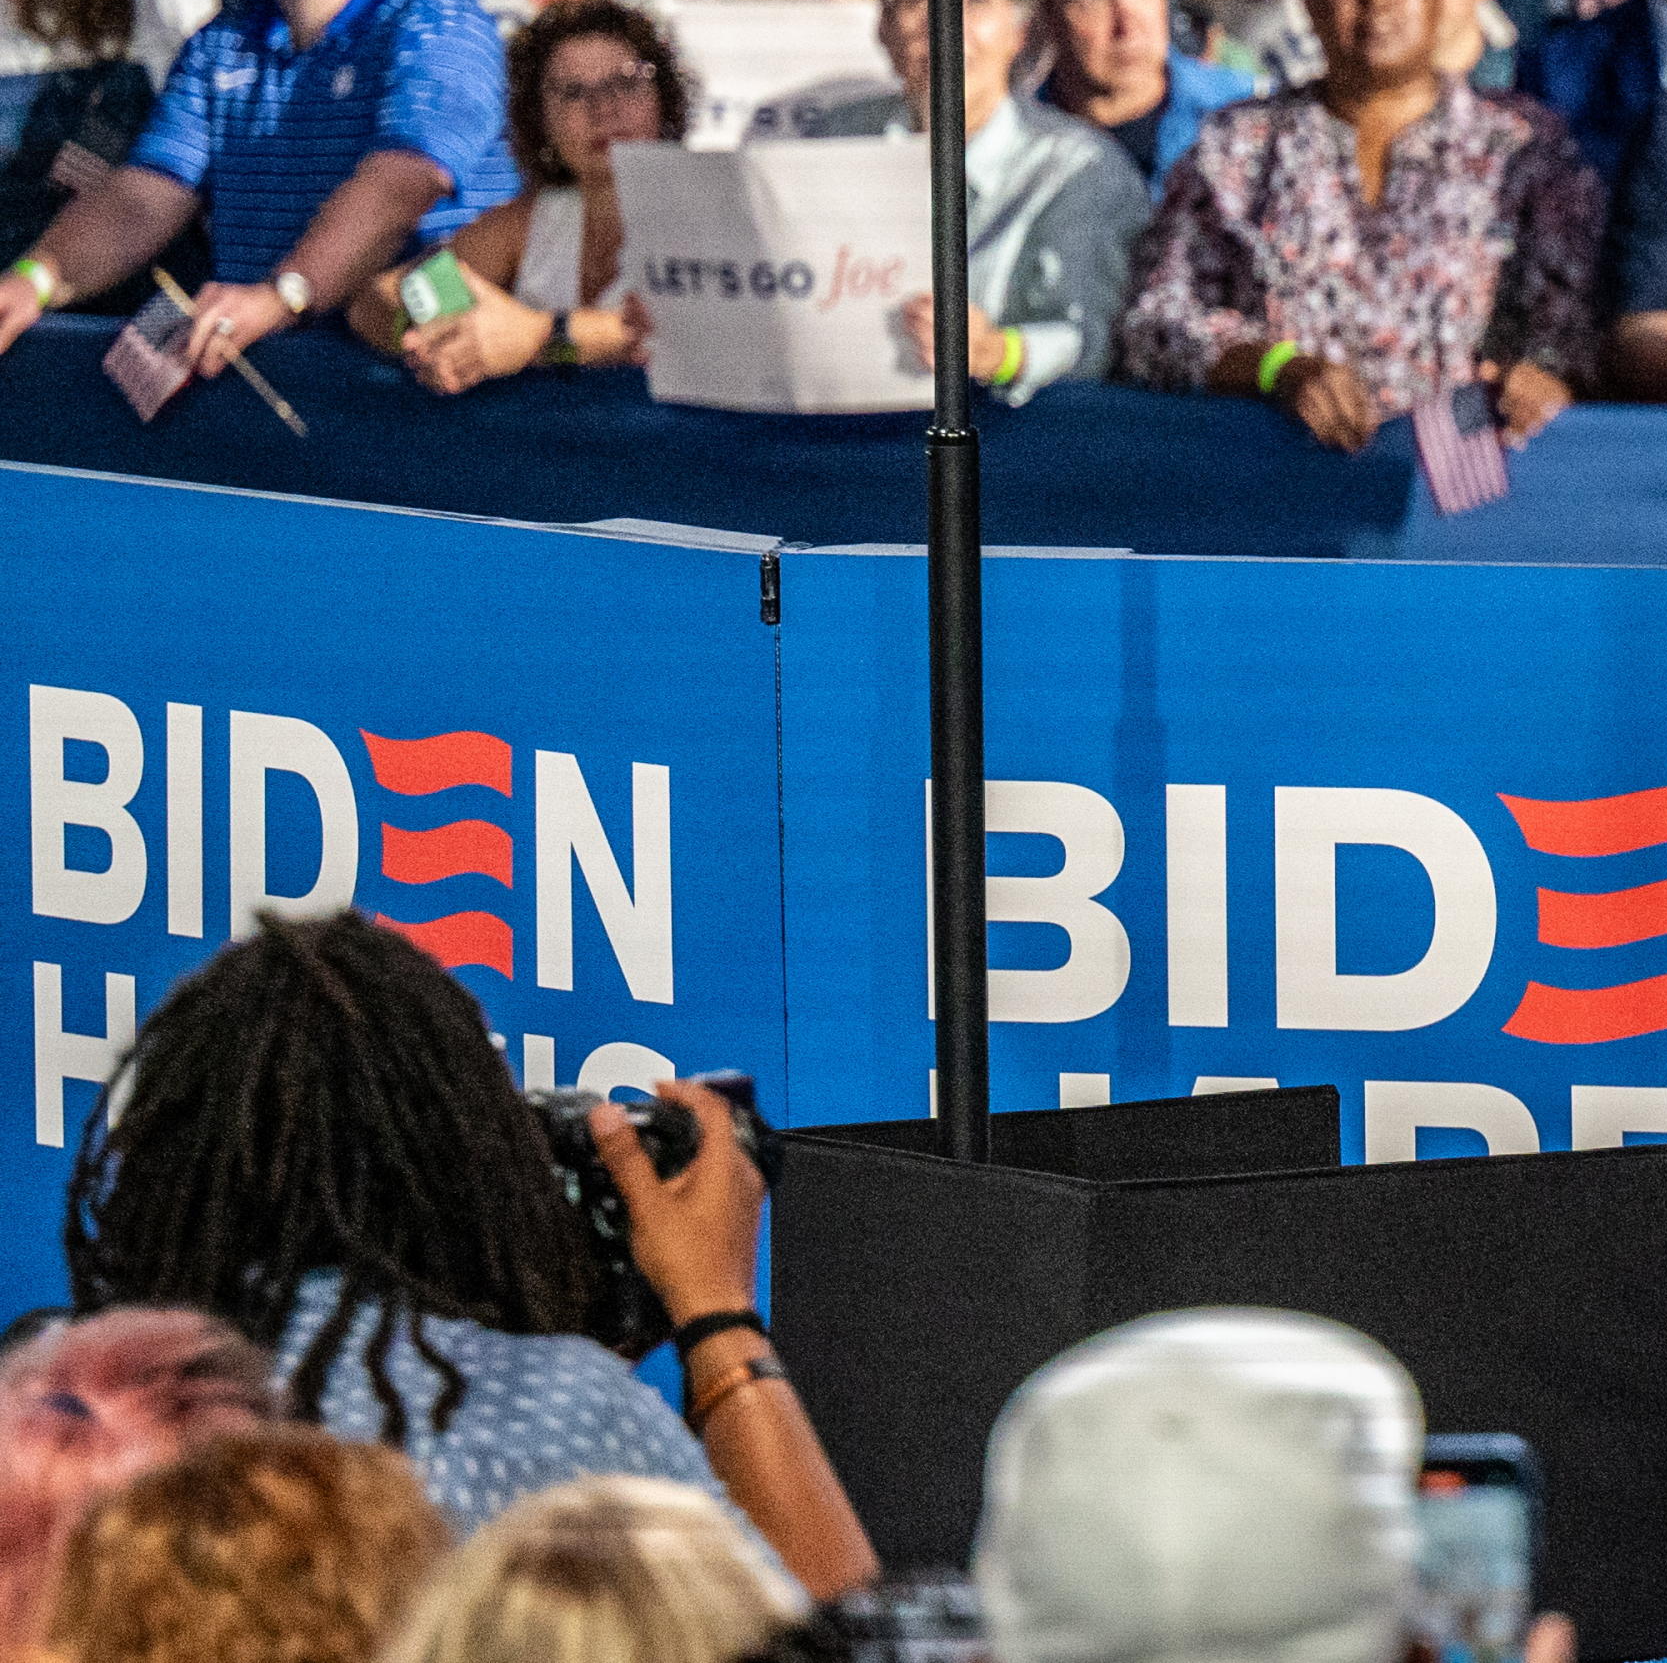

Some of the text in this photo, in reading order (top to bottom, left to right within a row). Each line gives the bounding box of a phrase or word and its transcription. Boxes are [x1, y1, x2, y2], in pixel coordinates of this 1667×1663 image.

[643, 241, 908, 309] LET'S GO Joe
[29, 683, 675, 1006] BIDEN
